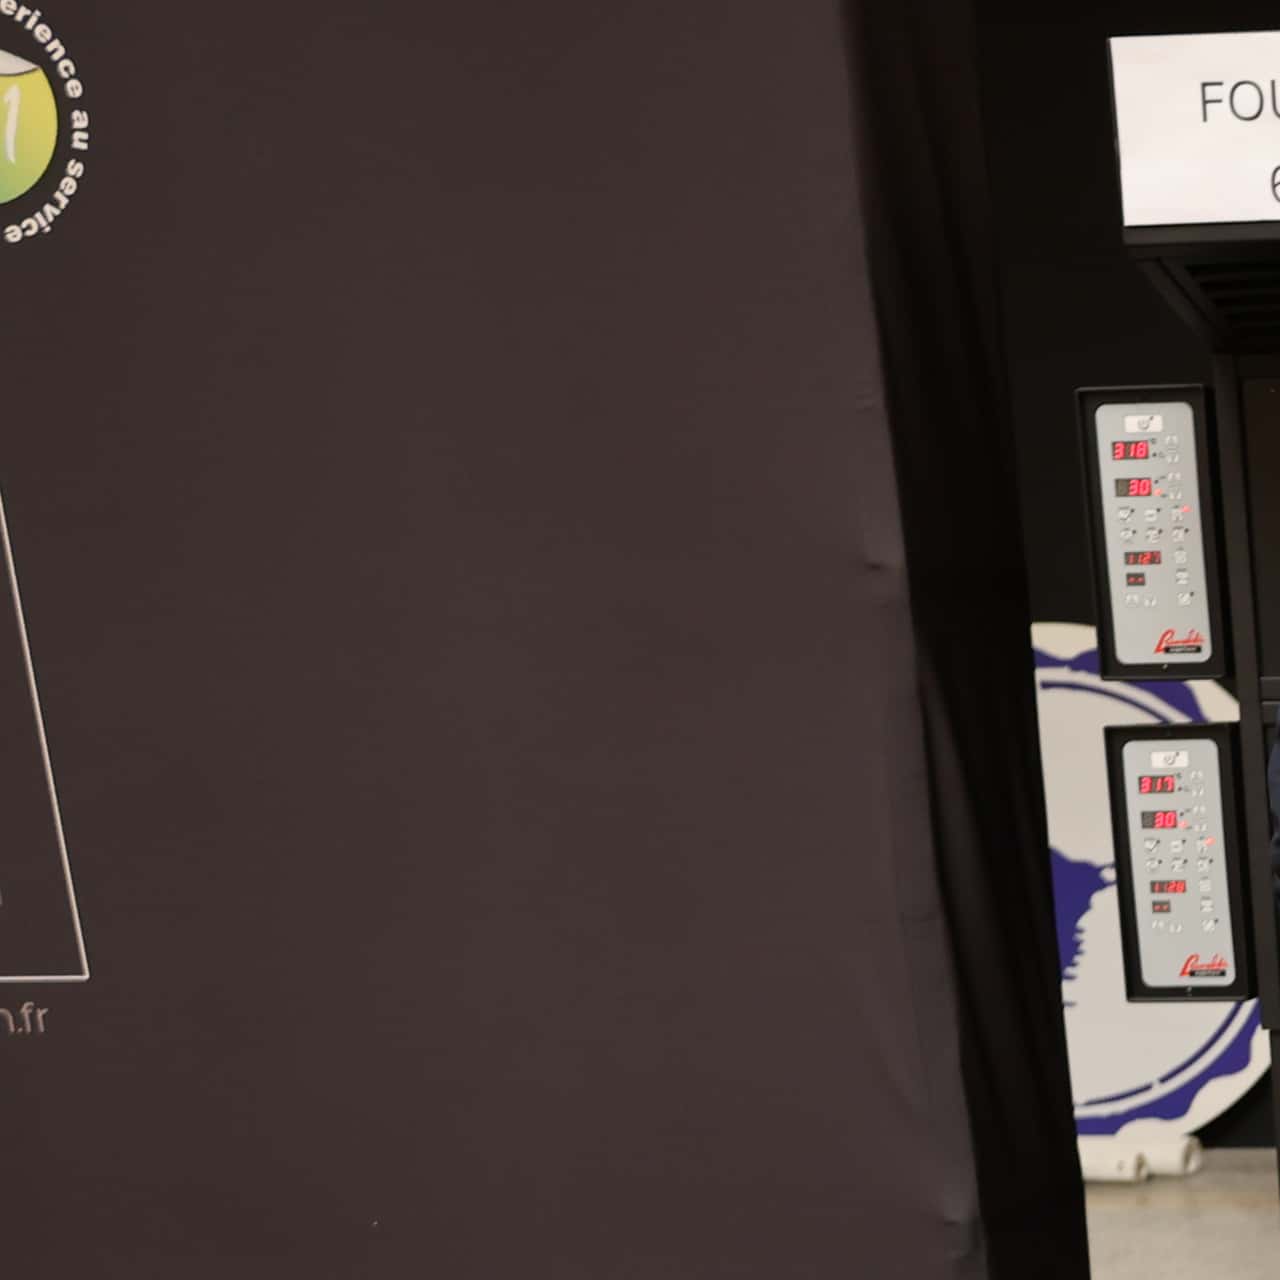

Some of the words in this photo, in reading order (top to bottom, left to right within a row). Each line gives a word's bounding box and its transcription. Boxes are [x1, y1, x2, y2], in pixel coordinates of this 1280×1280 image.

[71, 109, 89, 150] au
[4, 158, 84, 243] service
[1114, 441, 1148, 460] 318
[1129, 479, 1151, 495] 30
[1140, 776, 1174, 793] 317
[1155, 812, 1177, 828] 30
